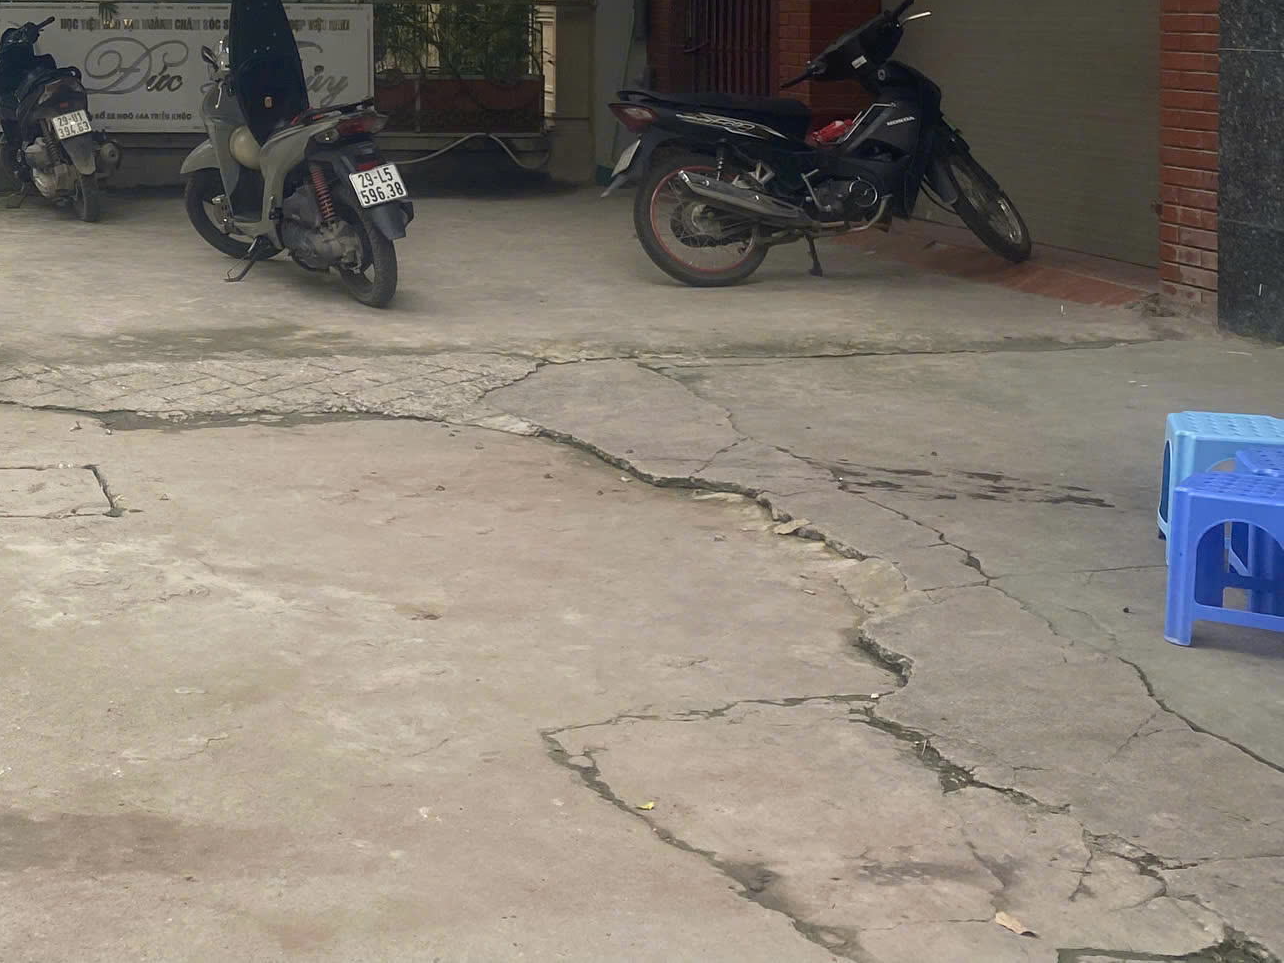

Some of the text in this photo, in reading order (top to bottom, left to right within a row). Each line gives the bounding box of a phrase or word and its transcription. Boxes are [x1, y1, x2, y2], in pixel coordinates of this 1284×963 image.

[57, 112, 83, 127] 29-U1
[357, 167, 394, 189] 29-L5
[360, 182, 404, 204] 596.38
